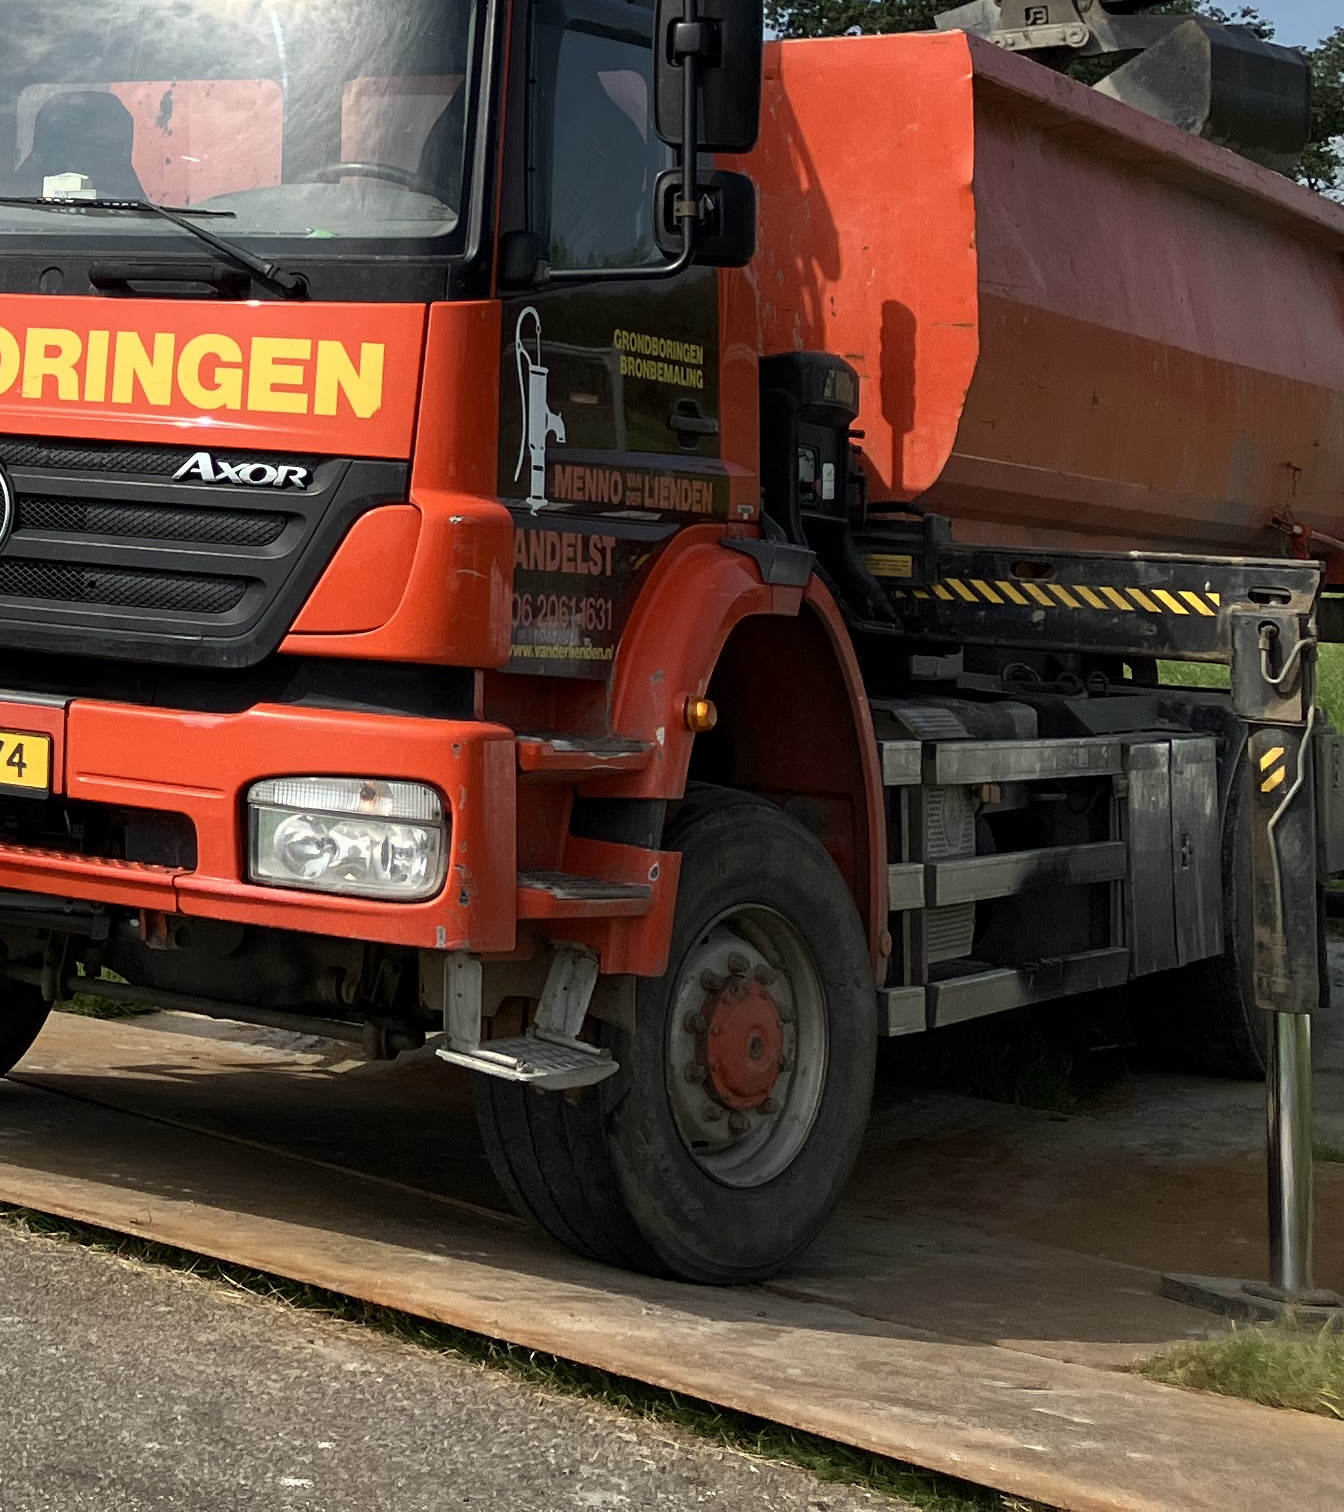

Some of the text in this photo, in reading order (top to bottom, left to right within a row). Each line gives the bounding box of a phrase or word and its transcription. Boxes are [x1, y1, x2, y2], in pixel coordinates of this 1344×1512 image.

[613, 328, 704, 366] GRONDBORINGEN
[620, 354, 704, 389] BRONBEMALING
[553, 464, 713, 513] MENNO VAN DER LIENDEN
[513, 528, 616, 577] ANDELST
[512, 593, 533, 628] 06
